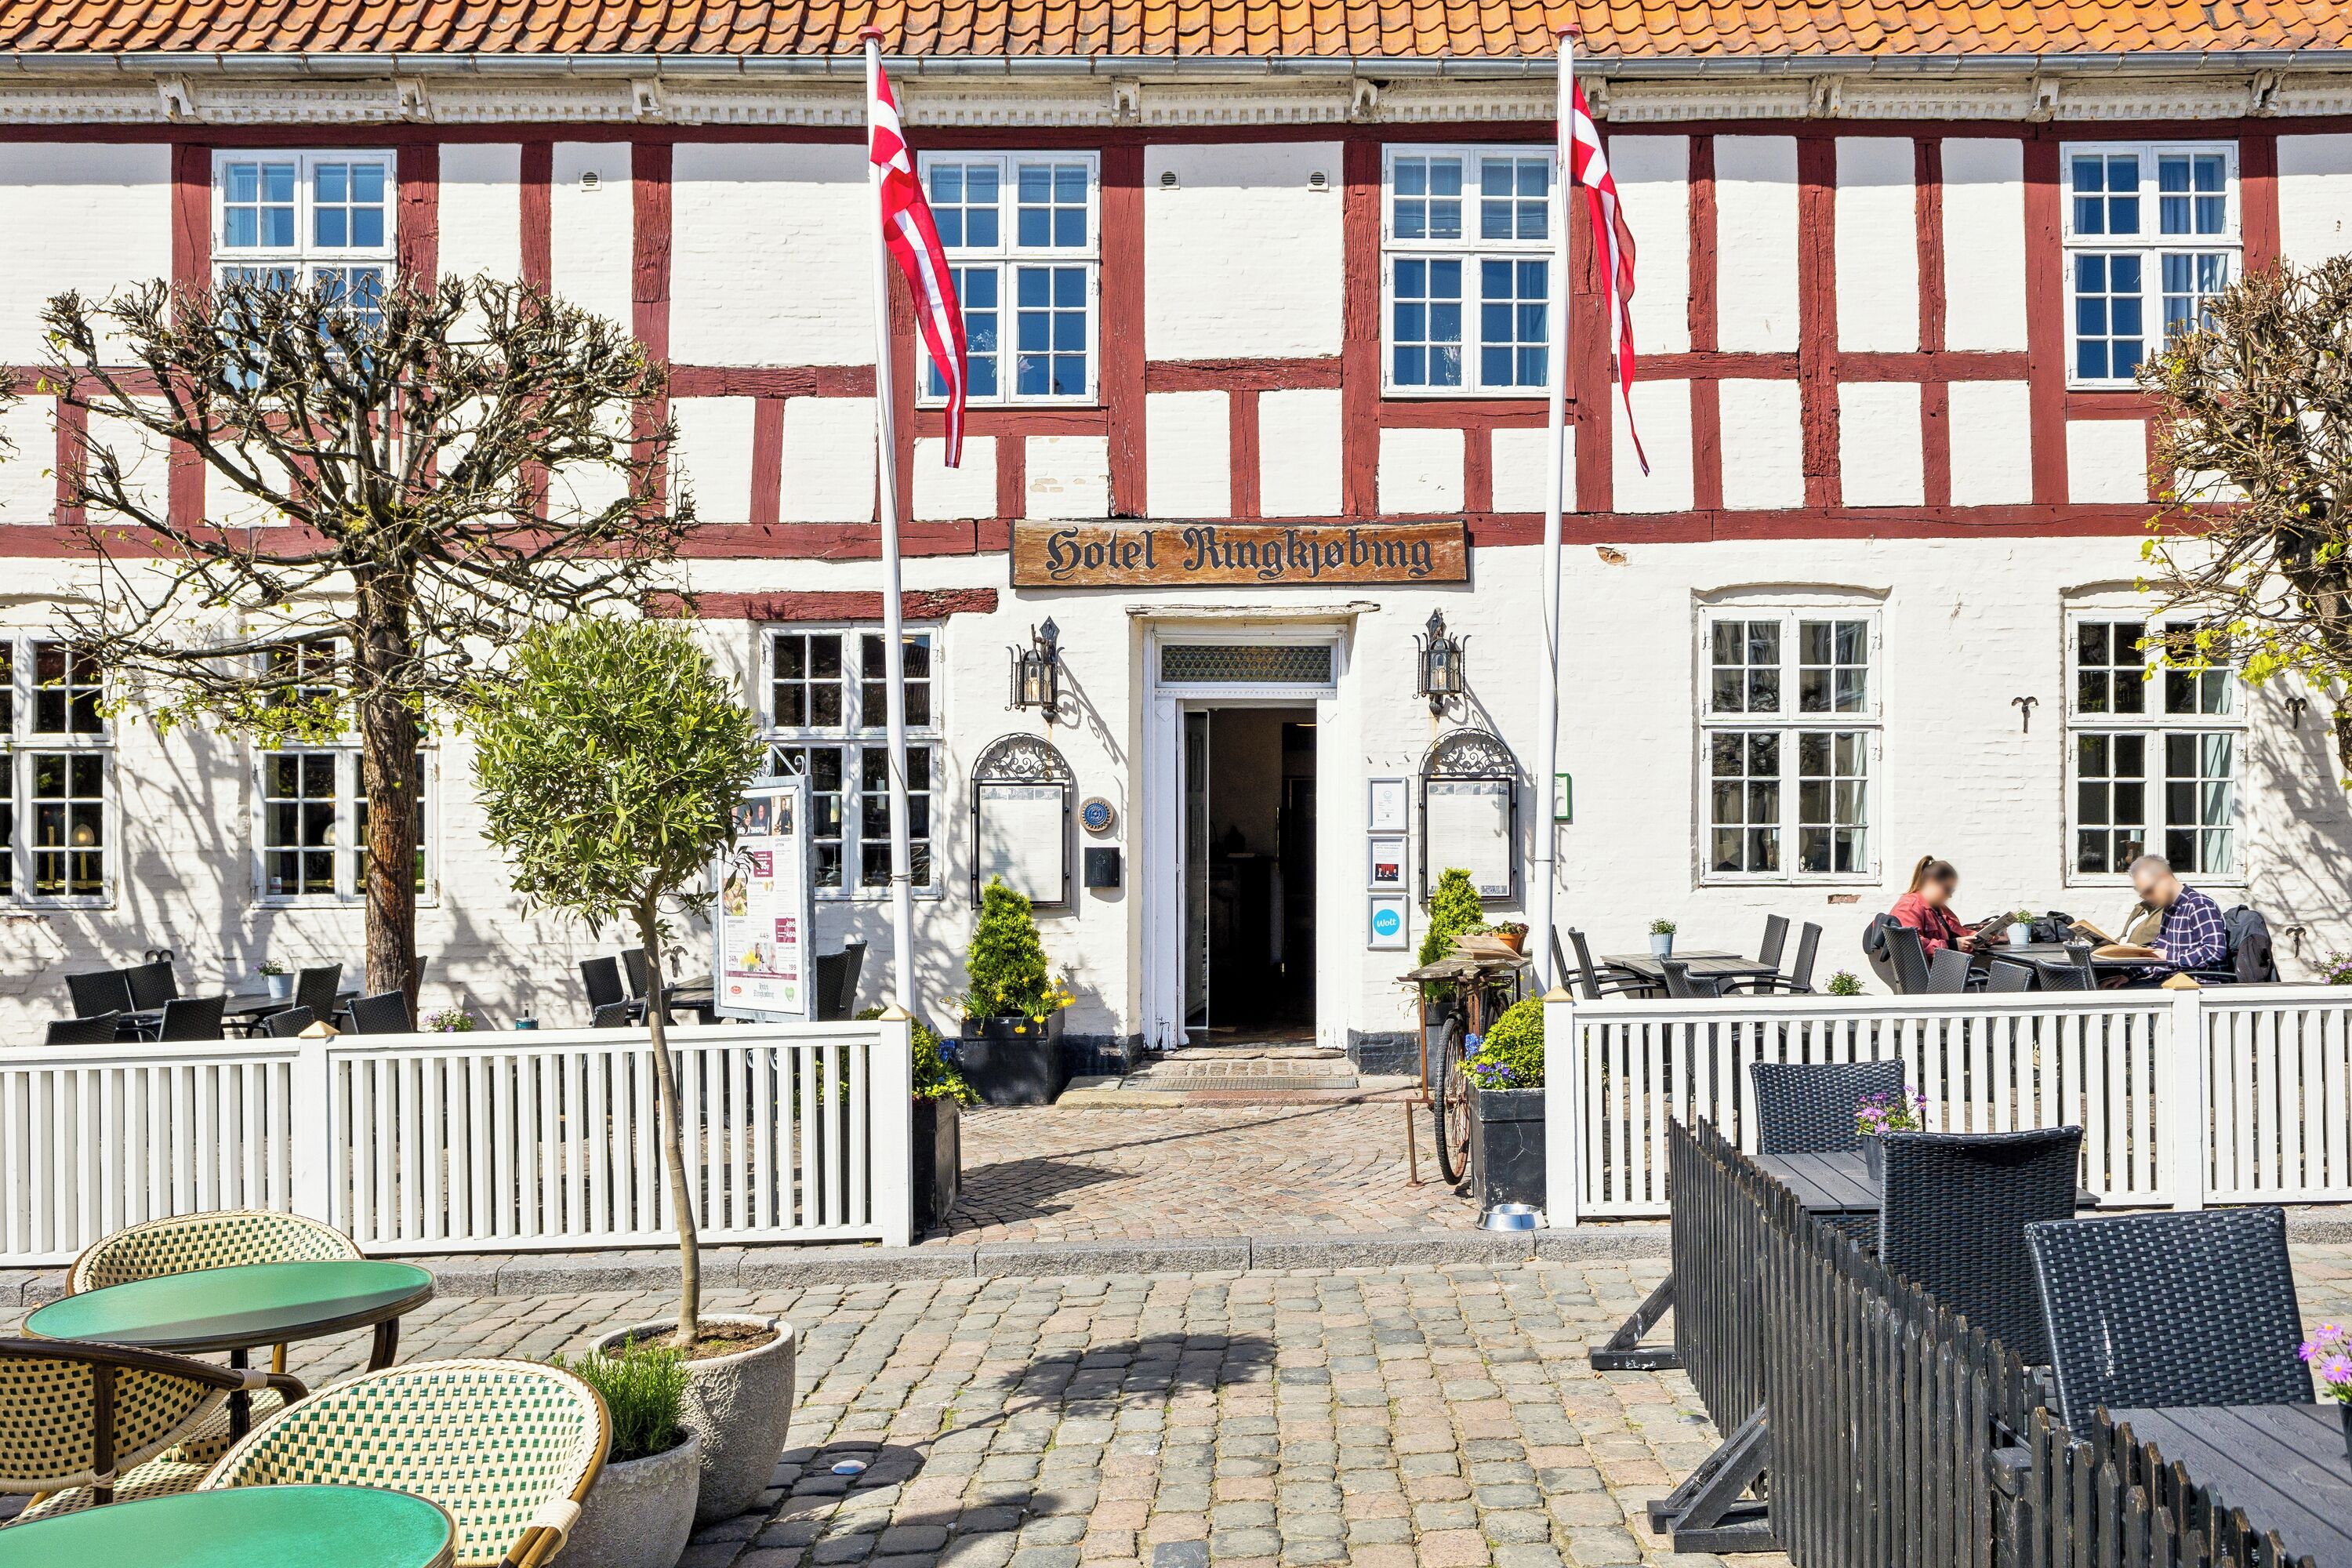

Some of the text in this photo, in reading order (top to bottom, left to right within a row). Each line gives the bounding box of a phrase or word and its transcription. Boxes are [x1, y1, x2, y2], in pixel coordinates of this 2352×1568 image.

[1046, 526, 1434, 580] Hotel Ringkjøbing
[1377, 918, 1396, 927] Wolt
